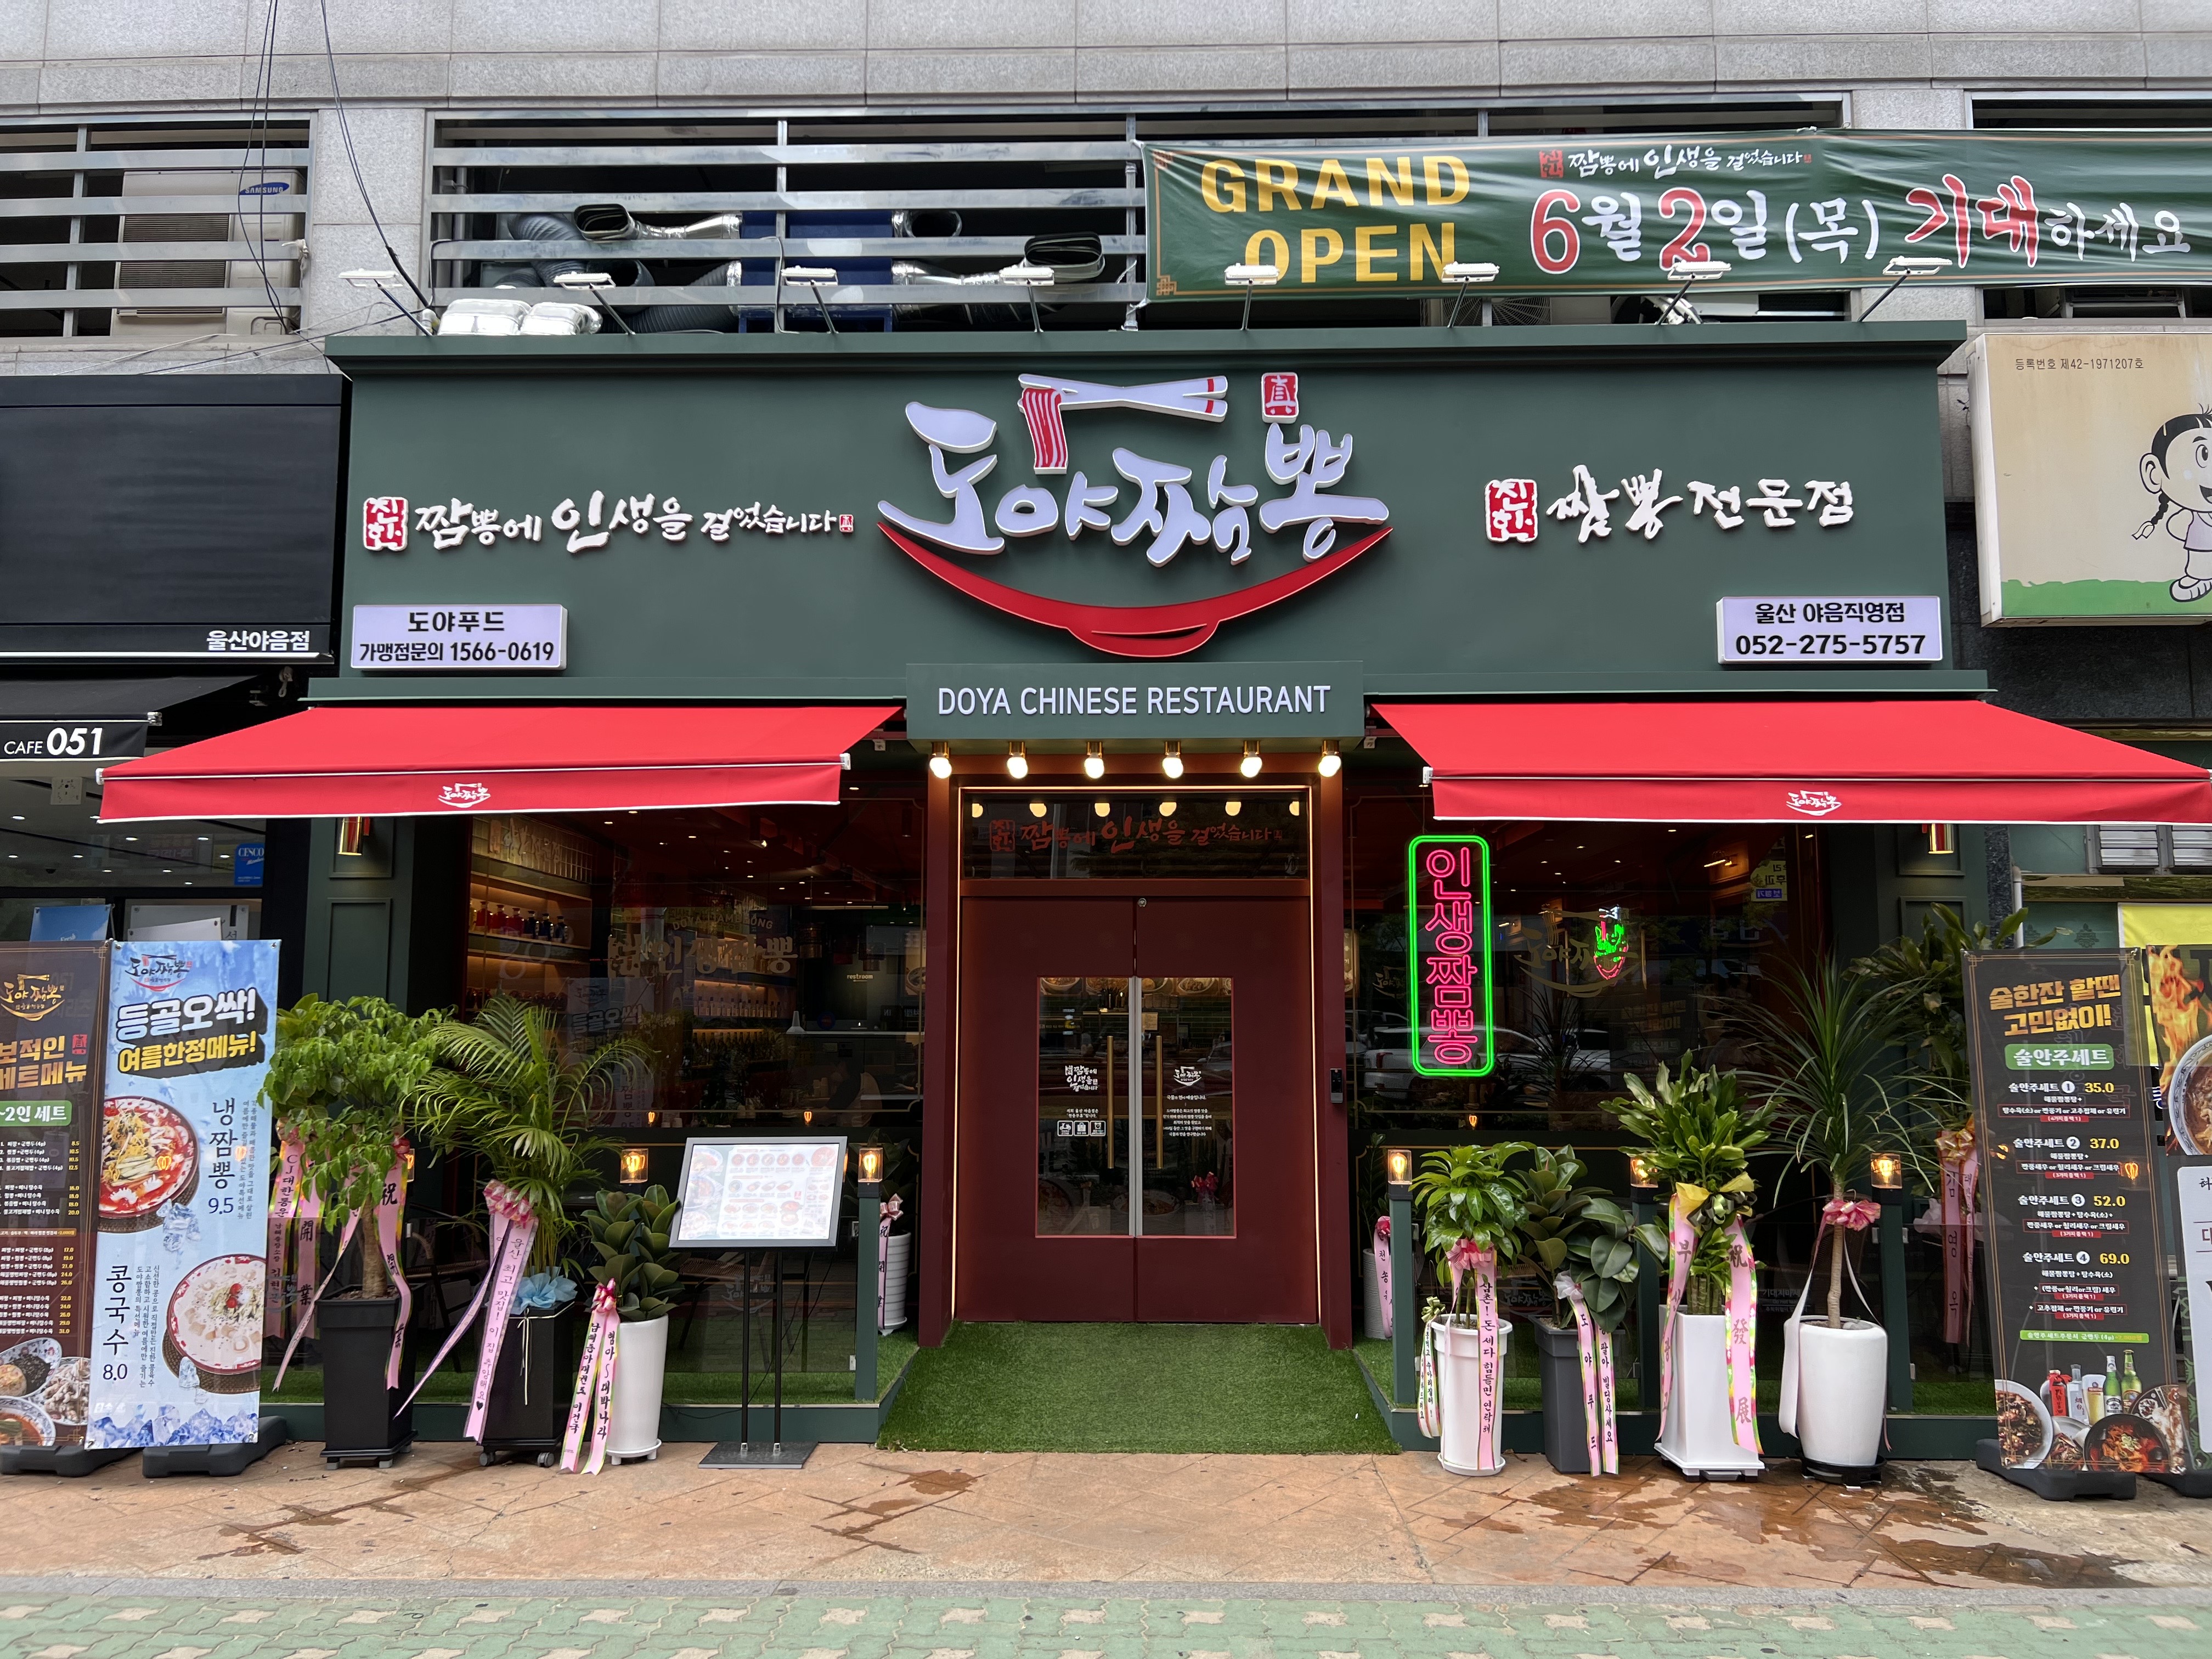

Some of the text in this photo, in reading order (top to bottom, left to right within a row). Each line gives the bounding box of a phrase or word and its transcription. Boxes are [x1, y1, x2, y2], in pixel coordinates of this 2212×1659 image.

[1568, 150, 1639, 177] 짬뽕에
[1644, 144, 1722, 179] 인생을
[1727, 149, 1803, 171] 걸었습니다
[1201, 155, 1470, 213] GRAND
[1531, 189, 1642, 275] 6월
[1245, 222, 1455, 283] OPEN
[2015, 357, 2144, 370] 등록번호 제42-1971207호
[1687, 478, 1854, 530] 전문점
[415, 498, 543, 549] 짬뽕에
[551, 490, 693, 554] 인생을
[701, 501, 838, 542] 걸었습니다
[408, 611, 505, 633] 도야푸드
[1756, 602, 1905, 624] 울산 야음직영점
[206, 630, 310, 651] 울산야음점
[359, 642, 554, 662] 가맹점문의 1566-0619
[1736, 634, 1926, 655] 052-275-5757
[938, 685, 1331, 715] DOYA CHINESE RESTAURANT
[4, 727, 103, 755] CAFE 051
[1020, 821, 1096, 850] 짬뽕에
[1102, 816, 1186, 854] 인생을
[1190, 822, 1272, 847] 걸었습니다
[1425, 847, 1478, 1065] 인생짬뽕
[1989, 974, 2121, 1011] 술한잔 할땐
[116, 987, 257, 1042] 등골오싹!
[2004, 1004, 2112, 1037] 고민없이!
[118, 1030, 257, 1073] 여름한정메뉴!
[2013, 1048, 2110, 1066] 술안주세트
[2008, 1082, 2115, 1093] 술안주세트 35.0
[34, 1105, 67, 1122] 세트
[209, 1097, 238, 1189] 냉짬뽕
[2013, 1138, 2119, 1149] 술안주세트 37.0
[208, 1197, 234, 1215] 9.5
[2018, 1195, 2126, 1206] 술안주세트 52.0
[2023, 1252, 2130, 1264] 술안주세트 69.0
[500, 1263, 516, 1285] 최고
[103, 1265, 132, 1356] 콩국수
[1479, 1282, 1493, 1317] 삼촌!
[1481, 1319, 1496, 1331] 돈
[103, 1363, 127, 1381] 8.0
[1482, 1362, 1495, 1397] 힘들면
